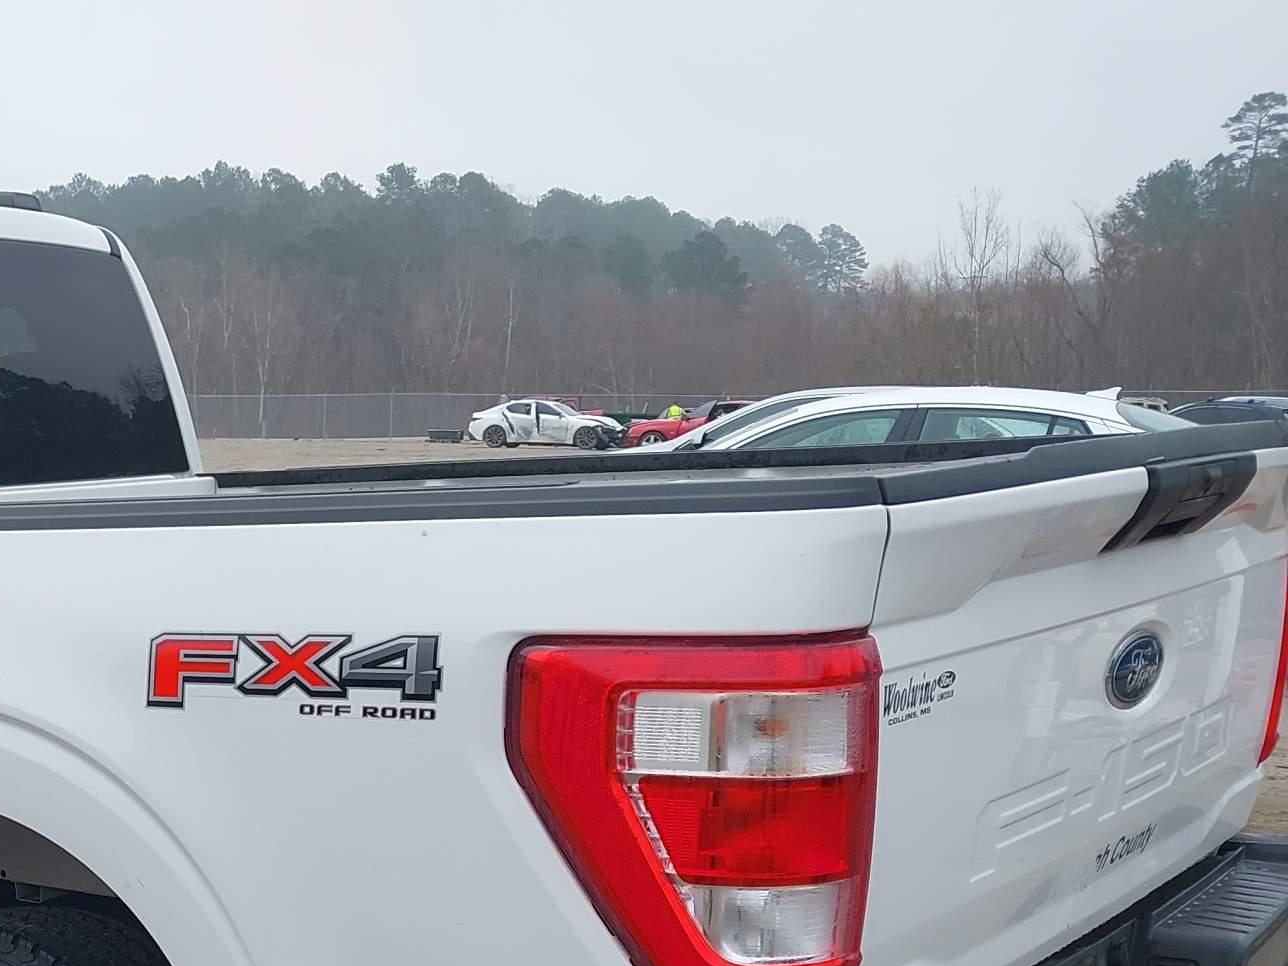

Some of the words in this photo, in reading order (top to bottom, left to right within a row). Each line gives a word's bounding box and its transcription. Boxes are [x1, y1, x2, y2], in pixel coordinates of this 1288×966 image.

[146, 632, 443, 709] FX4
[299, 704, 352, 718] OFF
[362, 707, 437, 721] ROAD
[883, 672, 937, 718] Woolwine
[920, 706, 932, 717] MS
[969, 694, 1239, 884] F-150
[1110, 823, 1158, 865] County
